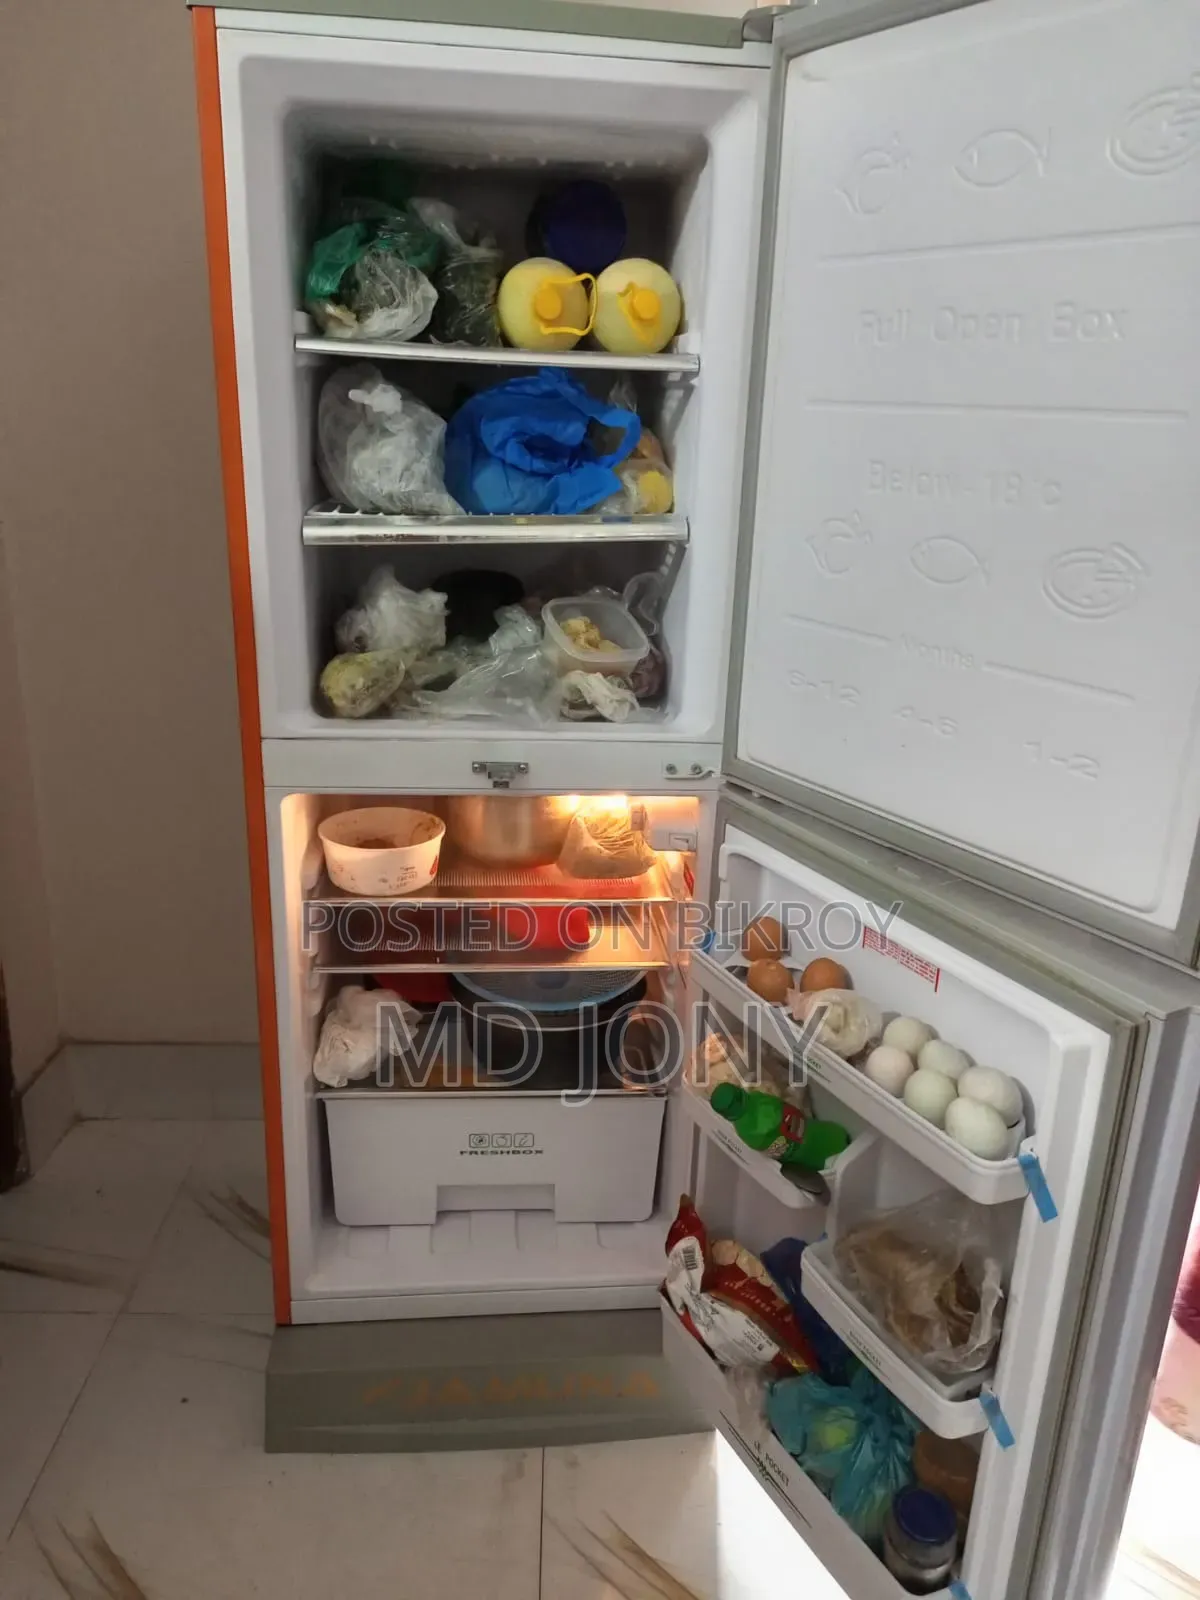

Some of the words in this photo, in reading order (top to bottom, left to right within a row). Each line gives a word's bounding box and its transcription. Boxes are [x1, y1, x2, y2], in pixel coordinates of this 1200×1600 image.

[930, 304, 1024, 346] Open
[1047, 299, 1131, 344] Box
[764, 1452, 790, 1487] POCKET
